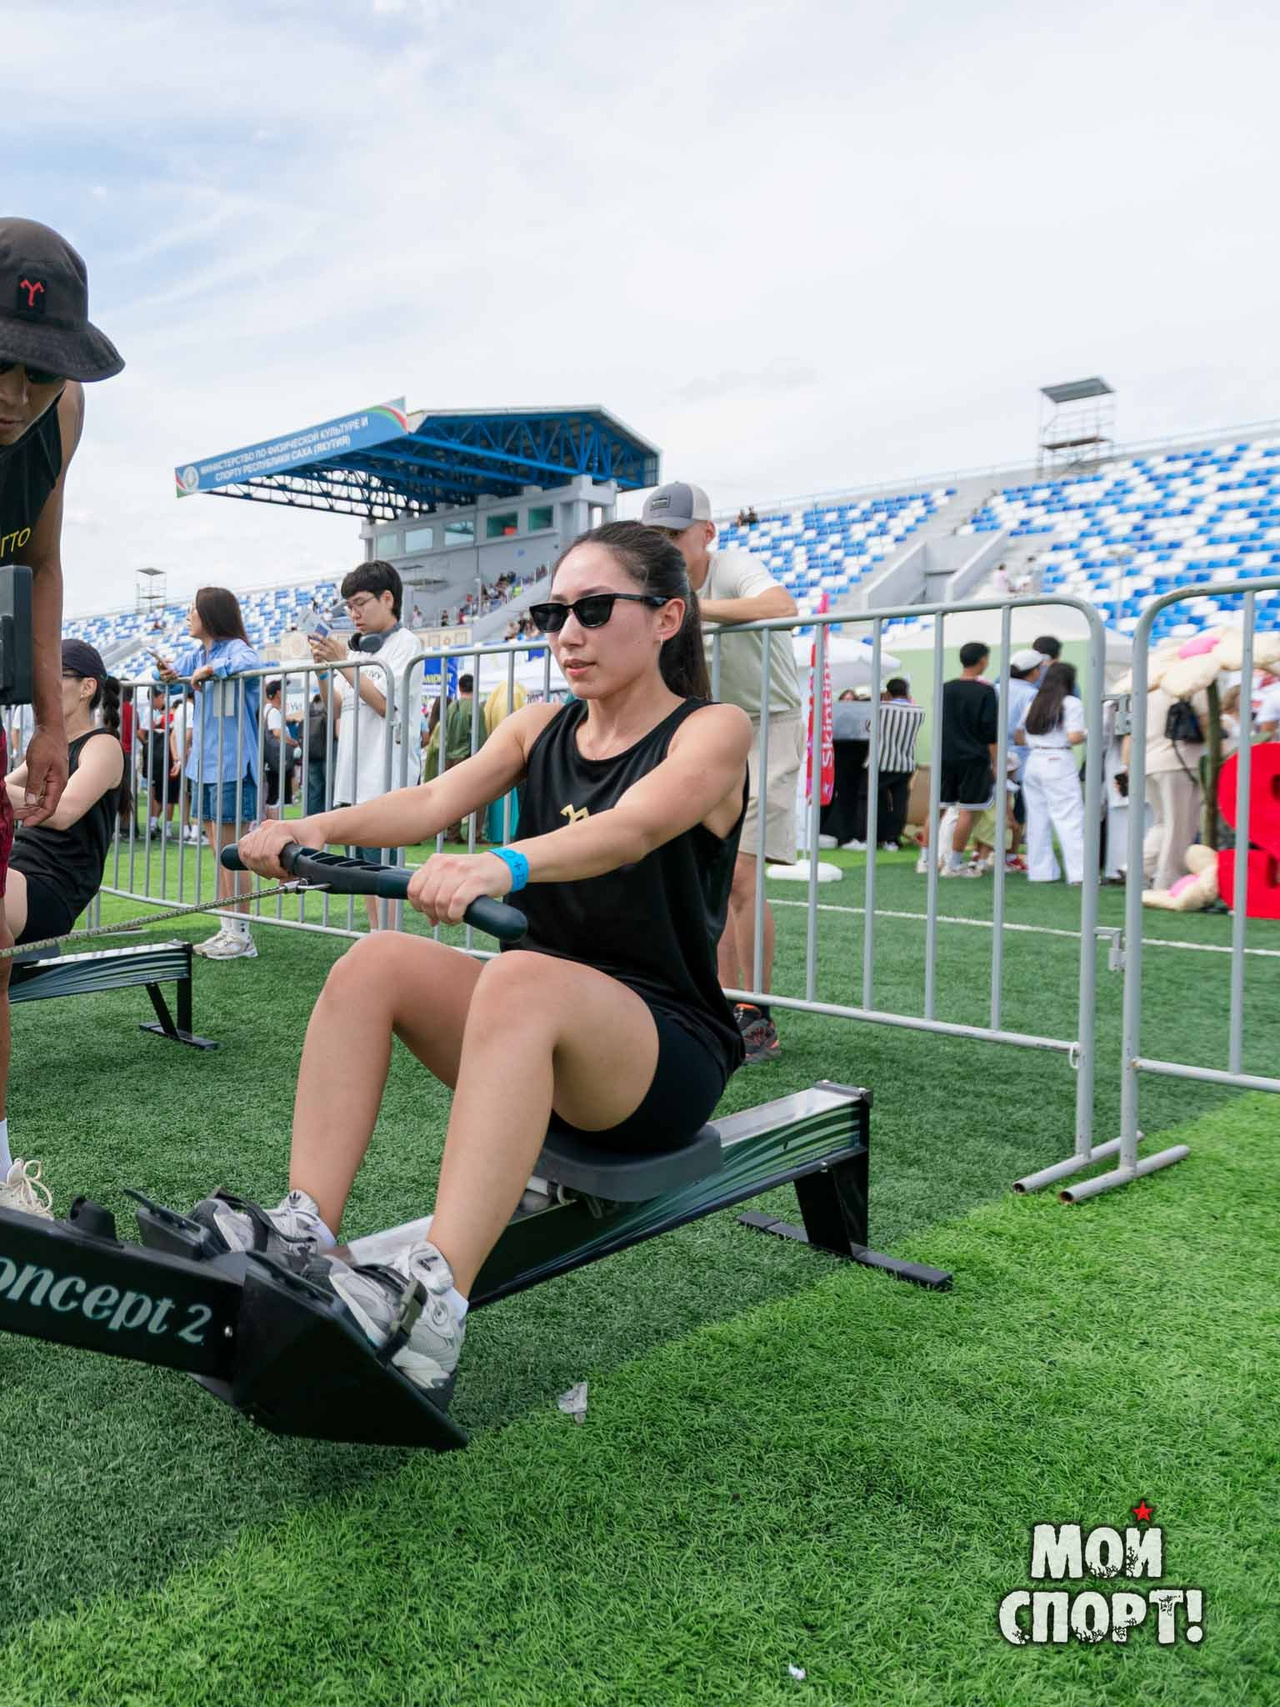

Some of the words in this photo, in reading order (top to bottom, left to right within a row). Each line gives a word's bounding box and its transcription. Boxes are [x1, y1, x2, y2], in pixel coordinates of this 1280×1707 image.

[200, 452, 255, 475] МИНИСТЕРСТВО
[255, 447, 267, 460] ПО
[267, 430, 320, 456] ФИЗИЧЕСКОЙ
[320, 418, 361, 440] КУЛЬТУРЕ
[214, 467, 242, 482] СПОРТУ
[243, 452, 290, 475] РЕСПУБЛИКИ
[291, 446, 313, 460] САХА
[176, 1303, 213, 1345] 2
